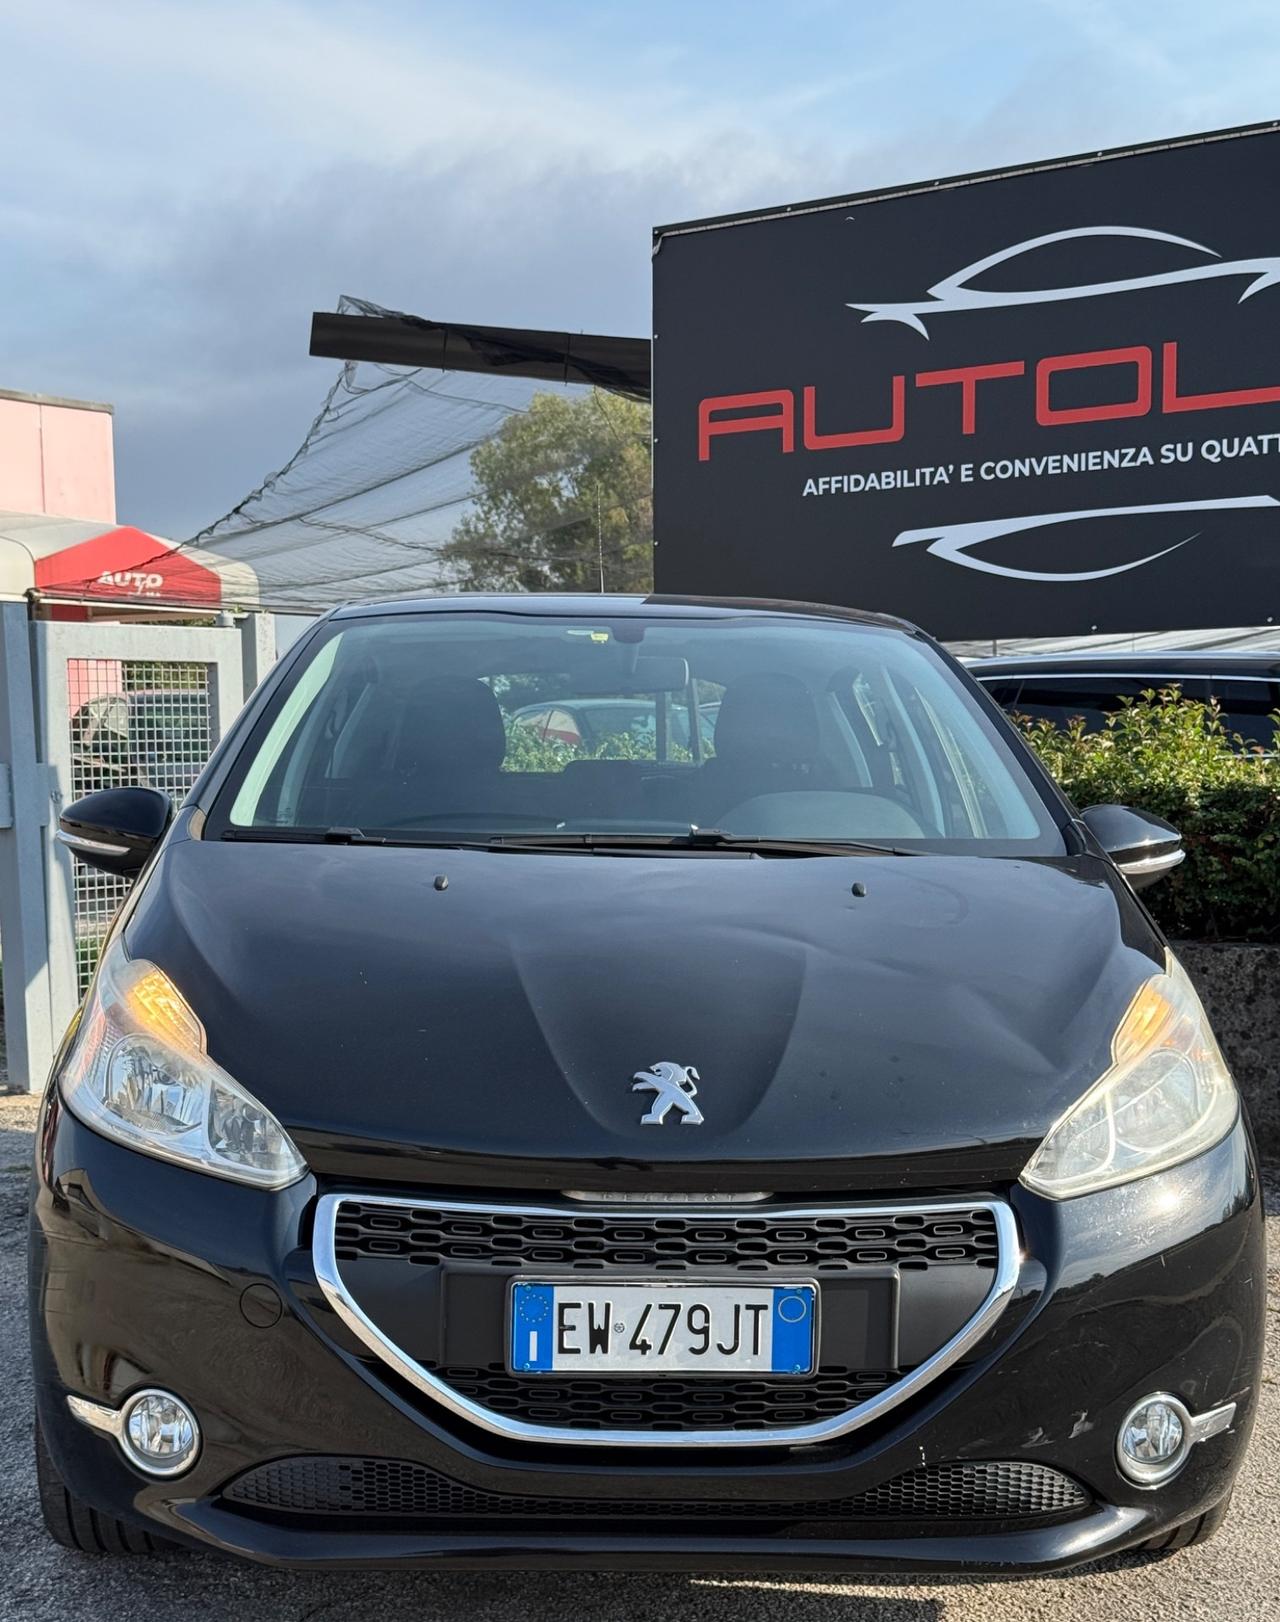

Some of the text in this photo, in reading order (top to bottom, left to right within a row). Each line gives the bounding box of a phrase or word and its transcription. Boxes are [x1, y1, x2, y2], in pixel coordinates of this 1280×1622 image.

[699, 342, 1280, 461] AUTOL
[802, 465, 953, 496] AFFIDABILITA’
[960, 464, 974, 482] E
[980, 447, 1154, 481] CONVENIENZA
[1160, 442, 1193, 464] SU
[97, 571, 163, 588] AUTO
[558, 1302, 769, 1356] EW 479JT
